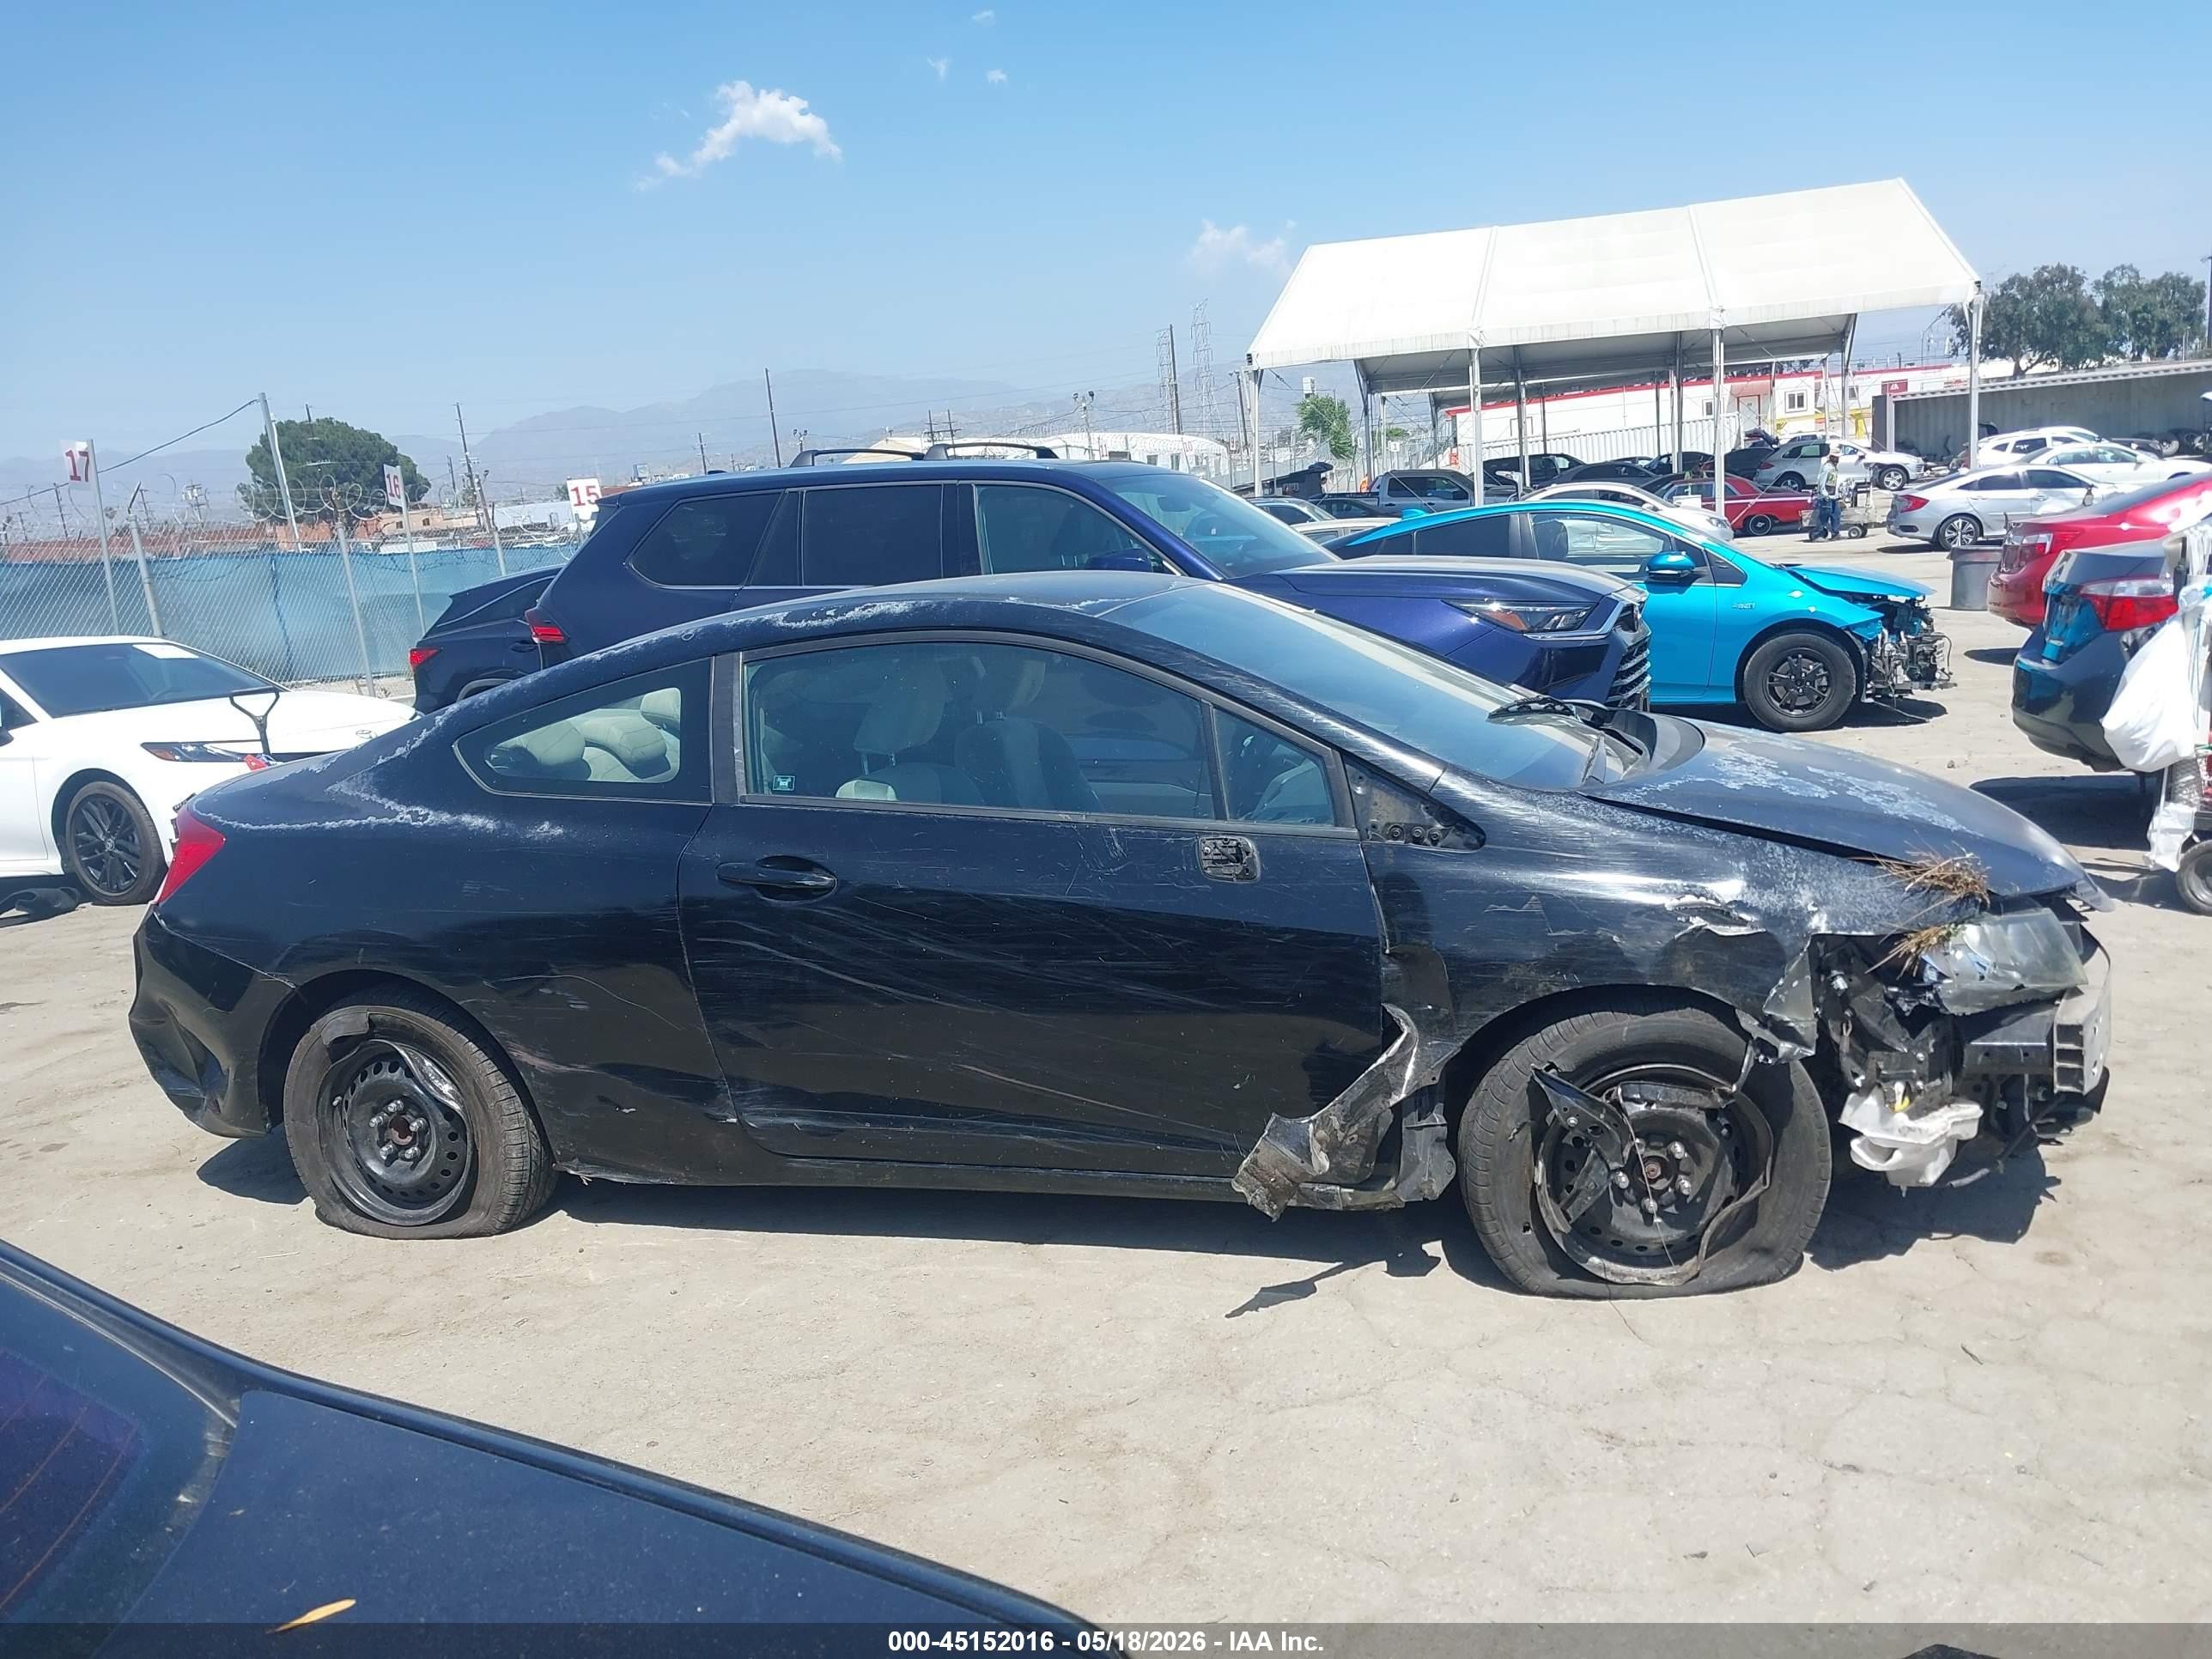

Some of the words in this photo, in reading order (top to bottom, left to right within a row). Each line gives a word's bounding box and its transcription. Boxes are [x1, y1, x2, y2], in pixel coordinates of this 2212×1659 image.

[65, 450, 89, 483] 17
[386, 474, 401, 499] 16
[570, 485, 599, 507] 15
